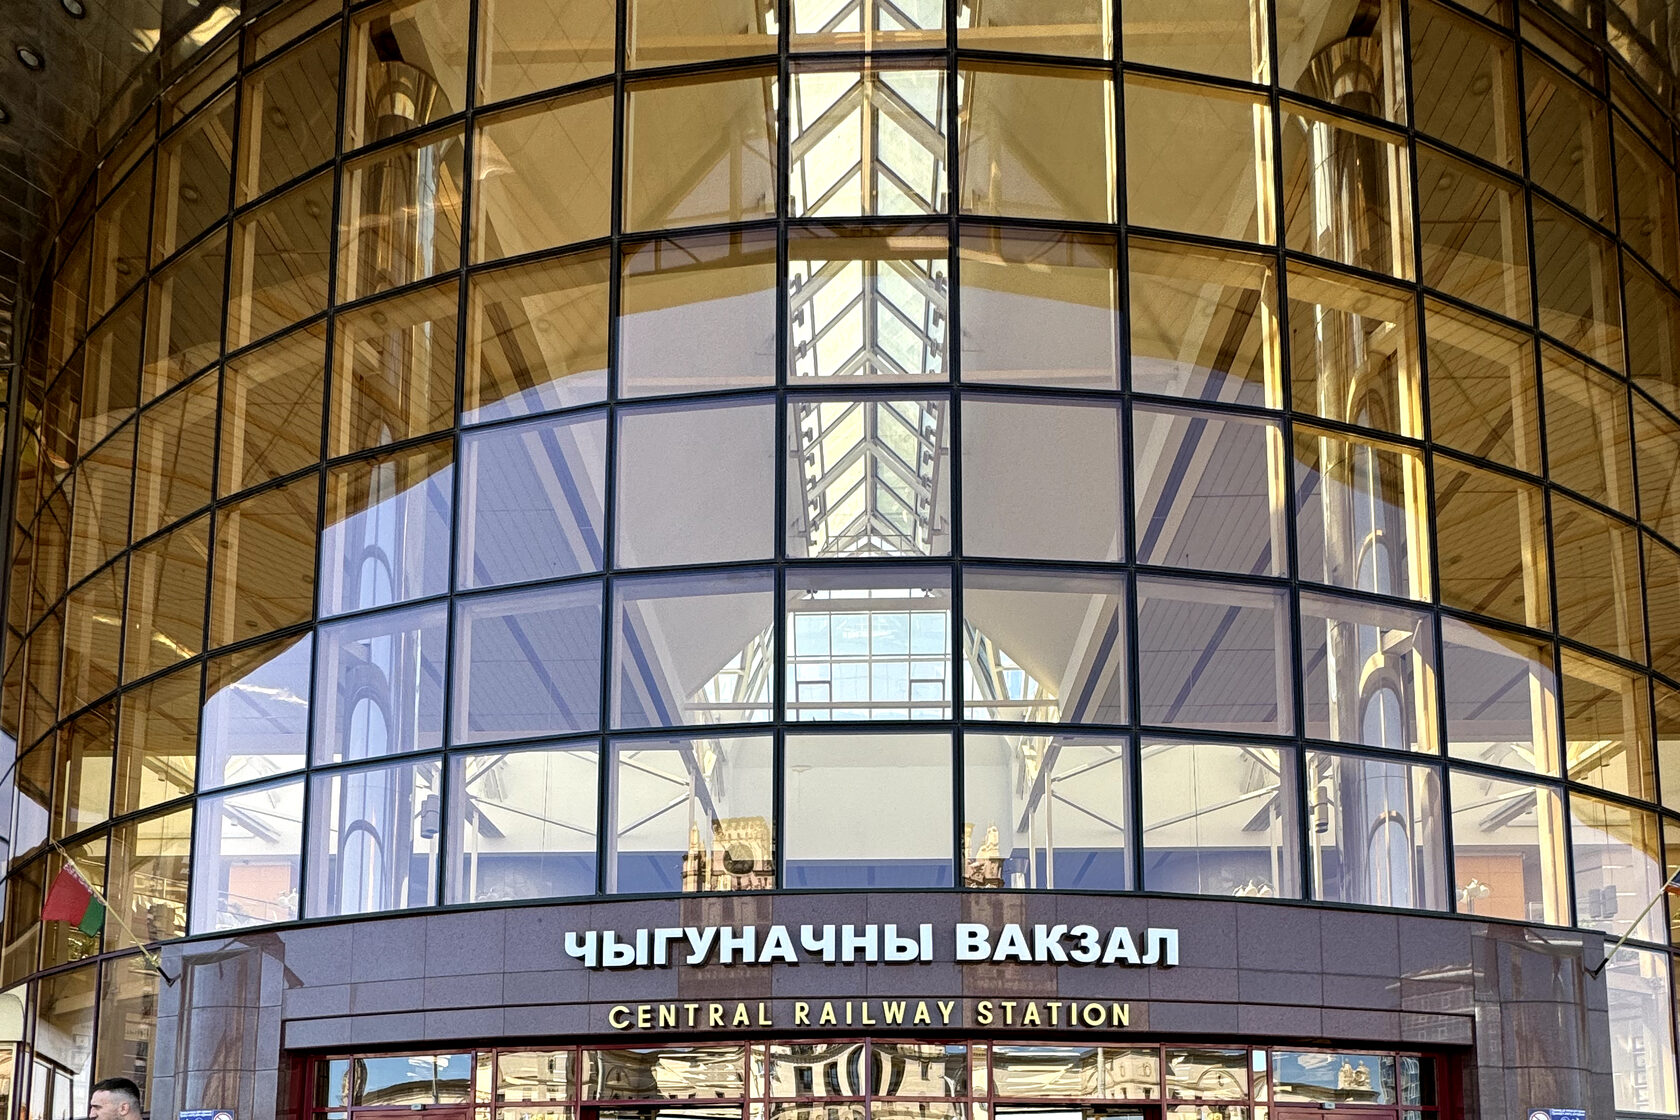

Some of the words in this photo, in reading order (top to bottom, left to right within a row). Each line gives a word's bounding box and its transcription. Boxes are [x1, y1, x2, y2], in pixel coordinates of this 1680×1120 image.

[564, 923, 933, 968] ЧЫГУНАЧНЫ
[956, 923, 1180, 967] ВАКЗАЛ
[608, 1001, 773, 1029] CENTRAL
[794, 1000, 955, 1026] RAILWAY
[976, 1000, 1130, 1028] STATION
